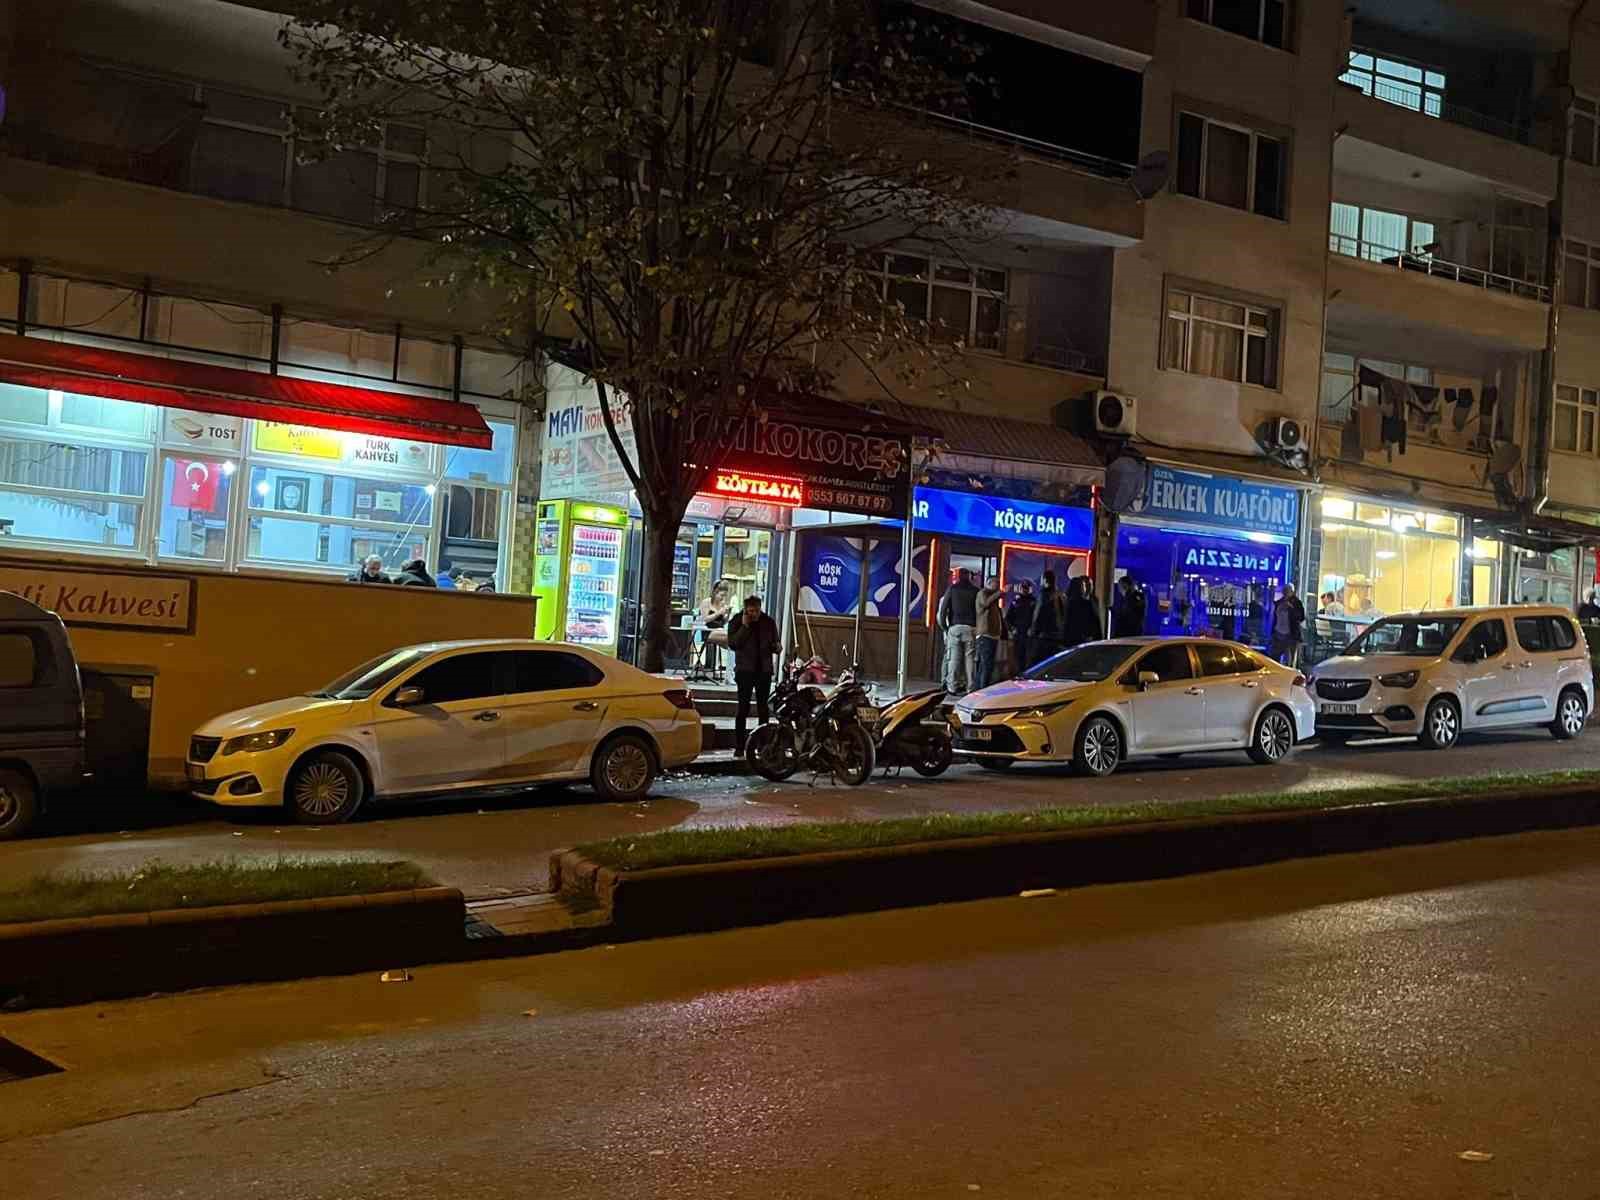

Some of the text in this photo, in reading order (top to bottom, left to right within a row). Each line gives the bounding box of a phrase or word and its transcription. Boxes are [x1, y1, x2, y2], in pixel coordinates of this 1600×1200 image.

[208, 426, 237, 440] TOST
[1152, 480, 1296, 525] ERKEK KUAFÖRÜ
[994, 508, 1066, 535] KÖŞK BAR
[818, 562, 842, 577] KÖŞK
[820, 575, 838, 587] BAR
[55, 585, 179, 618] Kahvesi
